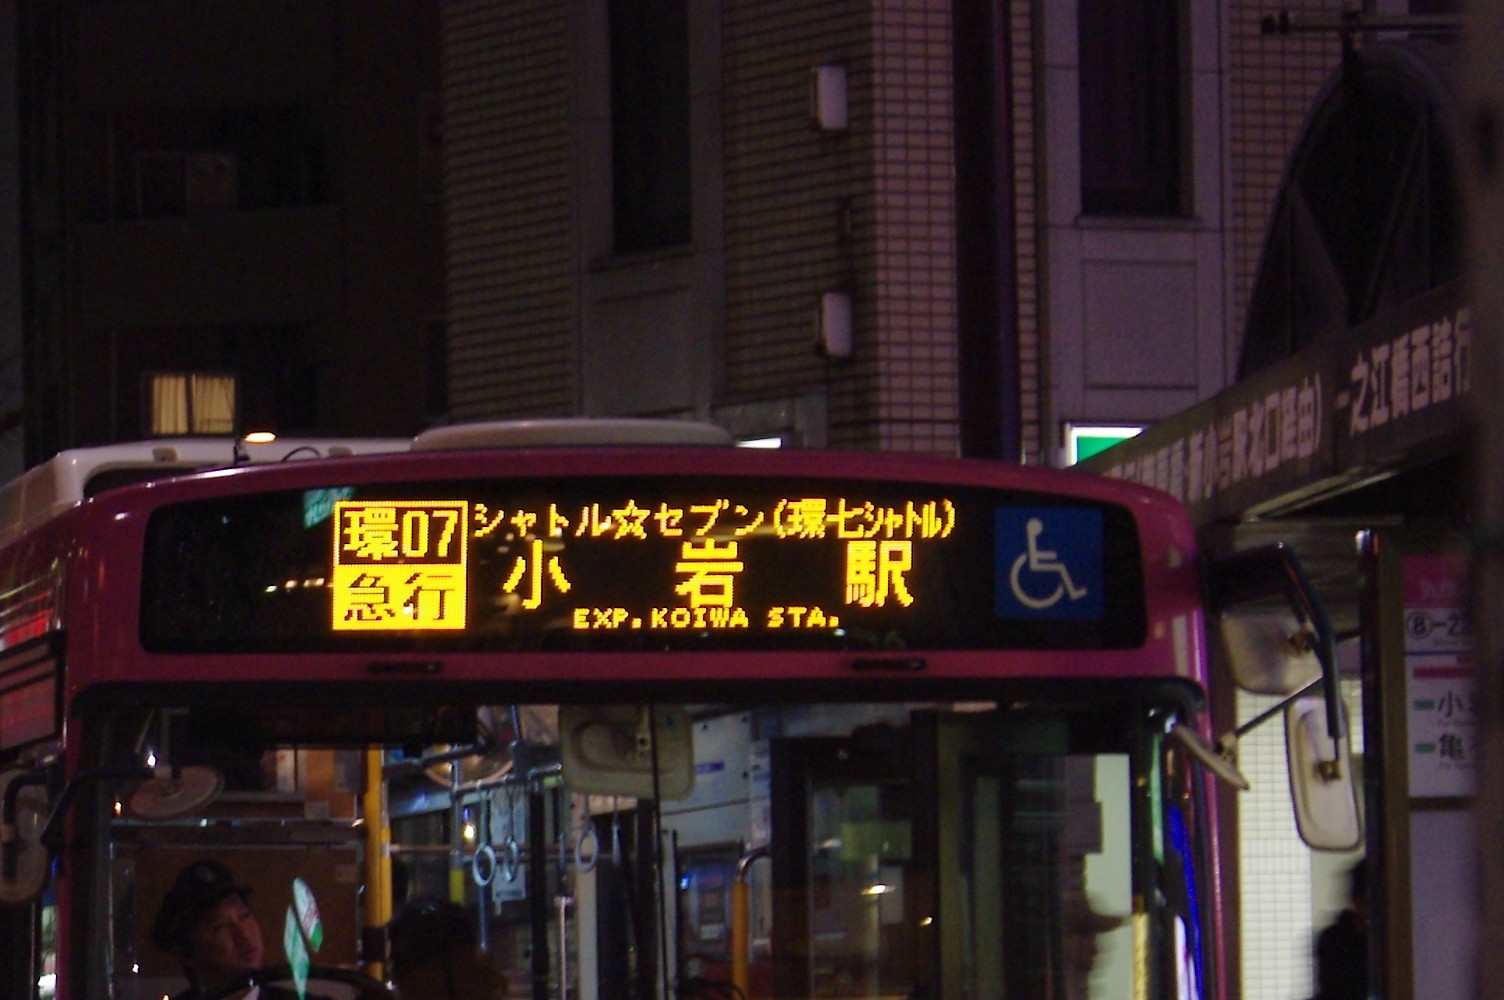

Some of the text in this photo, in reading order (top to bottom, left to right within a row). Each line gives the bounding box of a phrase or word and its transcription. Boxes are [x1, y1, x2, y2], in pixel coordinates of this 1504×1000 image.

[343, 507, 459, 560] 環07
[344, 572, 455, 621] 急行
[502, 537, 914, 610] 小岩駅
[767, 606, 839, 628] STA.
